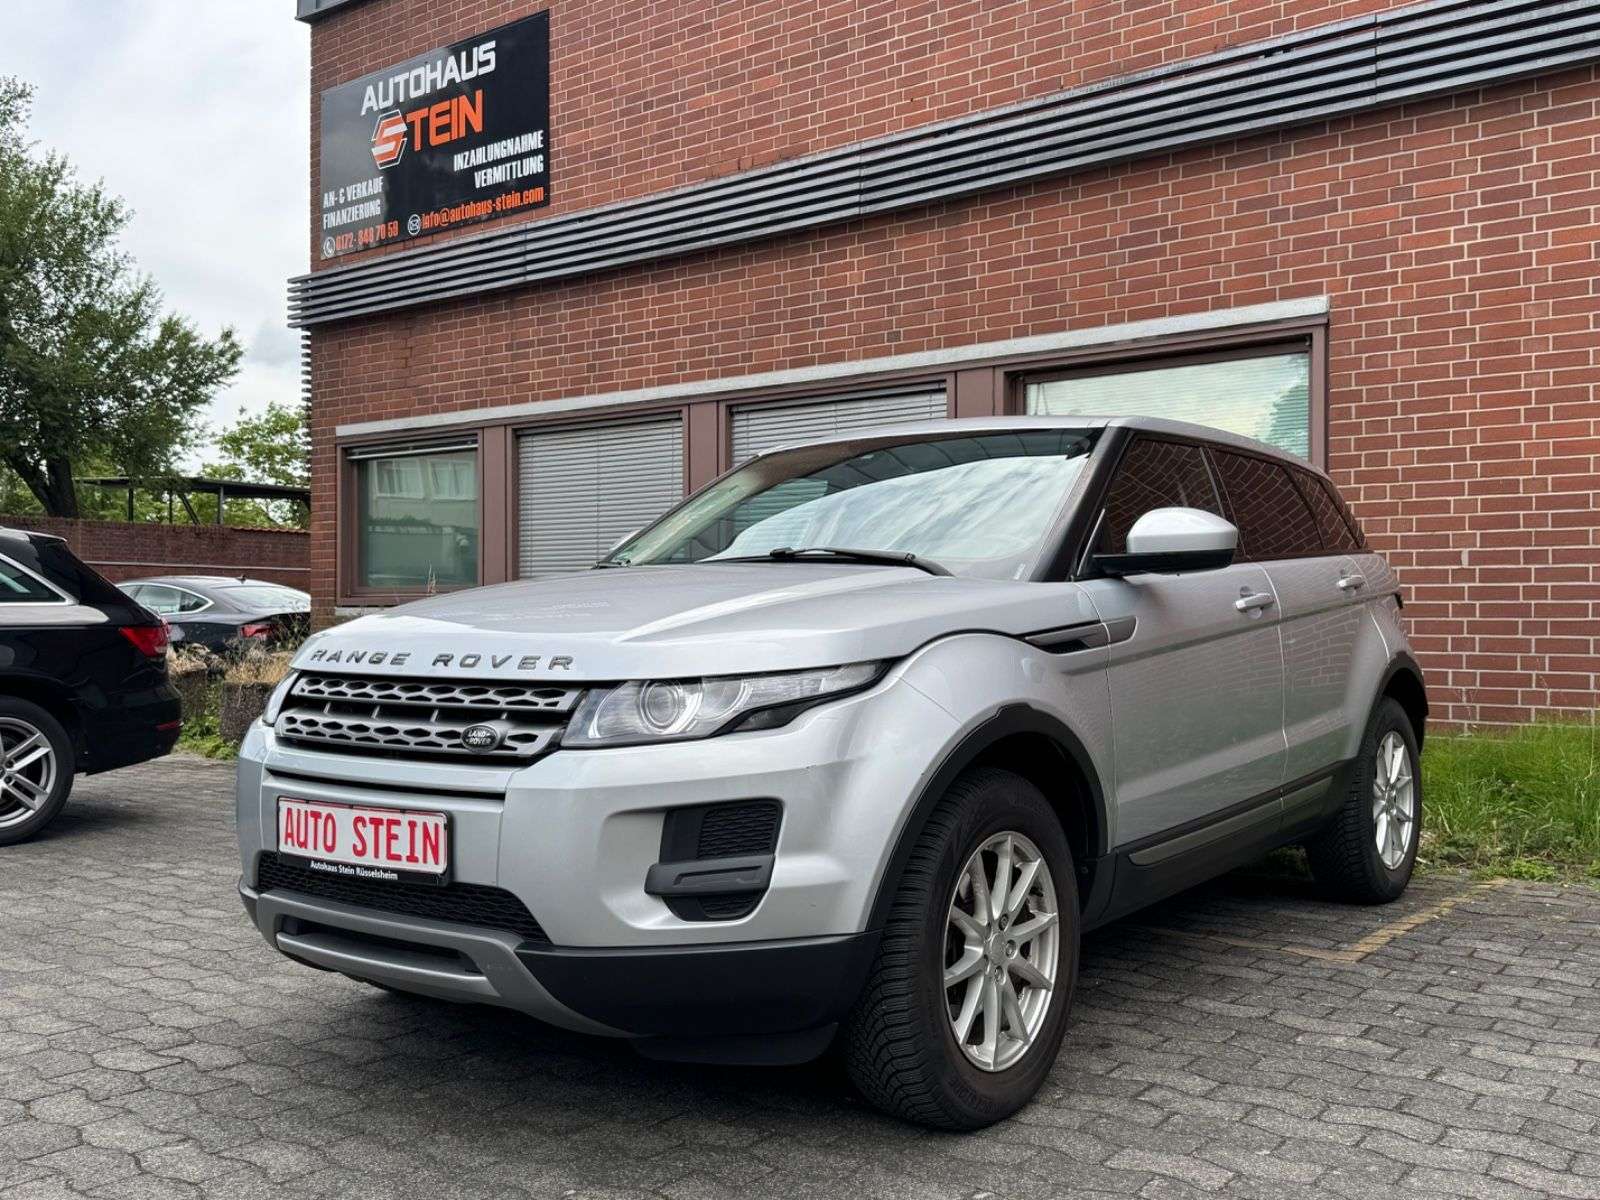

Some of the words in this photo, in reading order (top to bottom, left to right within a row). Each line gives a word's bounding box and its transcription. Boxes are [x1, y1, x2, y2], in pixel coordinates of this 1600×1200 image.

[360, 40, 496, 116] AUTOHAUS
[371, 89, 484, 169] STEIN
[453, 130, 544, 171] INZAHLUNGNAHME
[346, 176, 384, 202] VERKAUF
[474, 155, 544, 189] VERMITTLUNG
[323, 199, 381, 230] FINANZIERUNG
[422, 187, 544, 230] info@autohaus-stein.com
[310, 650, 411, 666] RANGE
[431, 653, 574, 670] ROVER
[468, 730, 486, 738] LAND
[284, 807, 337, 853] AUTO
[352, 816, 440, 865] STEIN
[310, 860, 338, 873] Autohaus
[338, 864, 355, 875] Stein
[356, 867, 398, 880] Rüsselsheim
